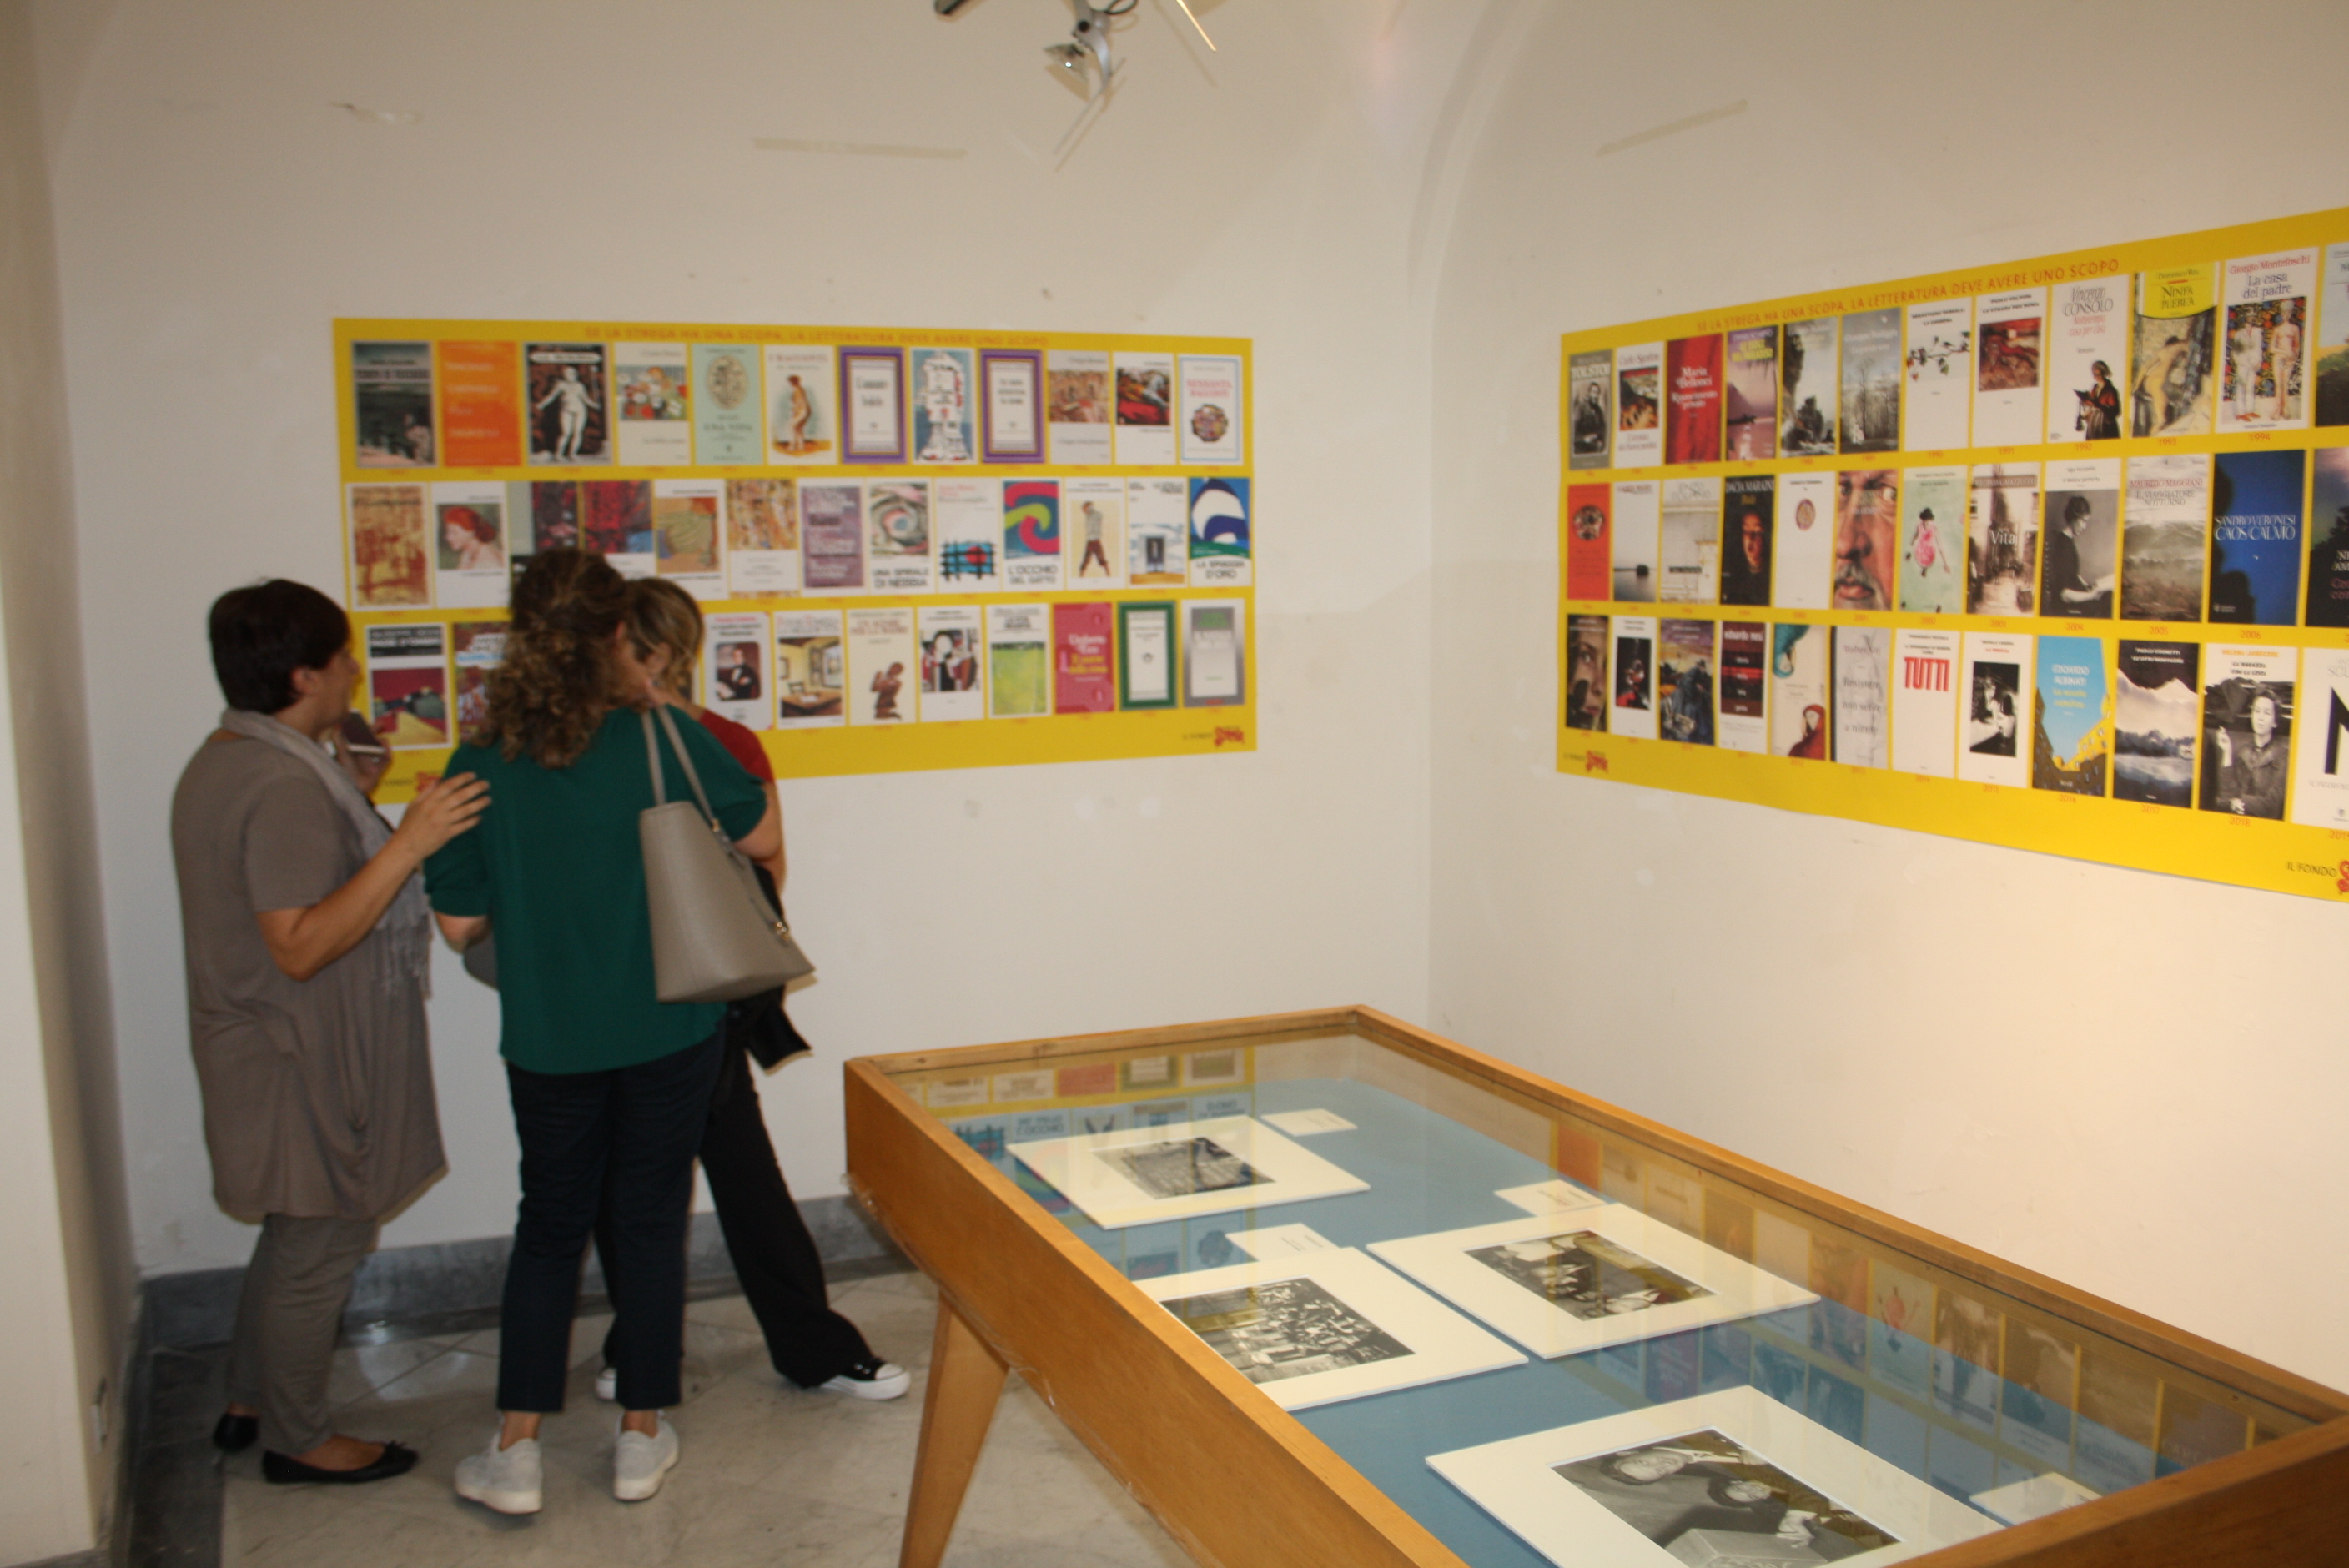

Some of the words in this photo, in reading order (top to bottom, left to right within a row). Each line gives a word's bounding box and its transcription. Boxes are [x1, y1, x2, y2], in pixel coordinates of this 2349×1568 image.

[2247, 274, 2261, 286] La
[2264, 273, 2288, 285] casa
[1697, 322, 1708, 332] SE
[1710, 320, 1722, 329] LA
[1724, 313, 1761, 329] STREGA
[1765, 310, 1779, 321] HA
[1783, 307, 1806, 320] UNA
[1851, 298, 1865, 309] LA
[1869, 286, 1947, 307] LETTERATURA
[1952, 279, 1984, 294] DEVE
[1988, 274, 2028, 289] AVERE
[2034, 267, 2065, 284] UNO
[2070, 259, 2119, 278] SCOPO
[2243, 286, 2259, 299] del
[2261, 284, 2293, 301] padre
[2064, 298, 2114, 316] CONSOLO
[586, 328, 600, 338] SE
[605, 329, 620, 338] LA
[626, 329, 674, 339] STREGA
[682, 330, 698, 339] HA
[704, 330, 732, 339] UNA
[811, 332, 894, 343] LETTERATURA
[900, 334, 929, 343] DEVE
[935, 334, 971, 344] AVERE
[975, 335, 1003, 344] UNO
[1008, 335, 1049, 345] SCOPO
[2158, 438, 2177, 447] 1993
[2249, 433, 2271, 441] 1994
[2215, 526, 2247, 541] CAOS
[2250, 525, 2296, 541] CALMO
[2149, 626, 2169, 635] 2005
[2240, 630, 2261, 639] 2006
[1904, 656, 1950, 692] TUTTI
[2059, 795, 2078, 804] 2016
[2140, 806, 2160, 816] 2017
[2229, 817, 2251, 827] 2018
[2286, 862, 2295, 872] IL
[2296, 862, 2337, 877] FONDO
